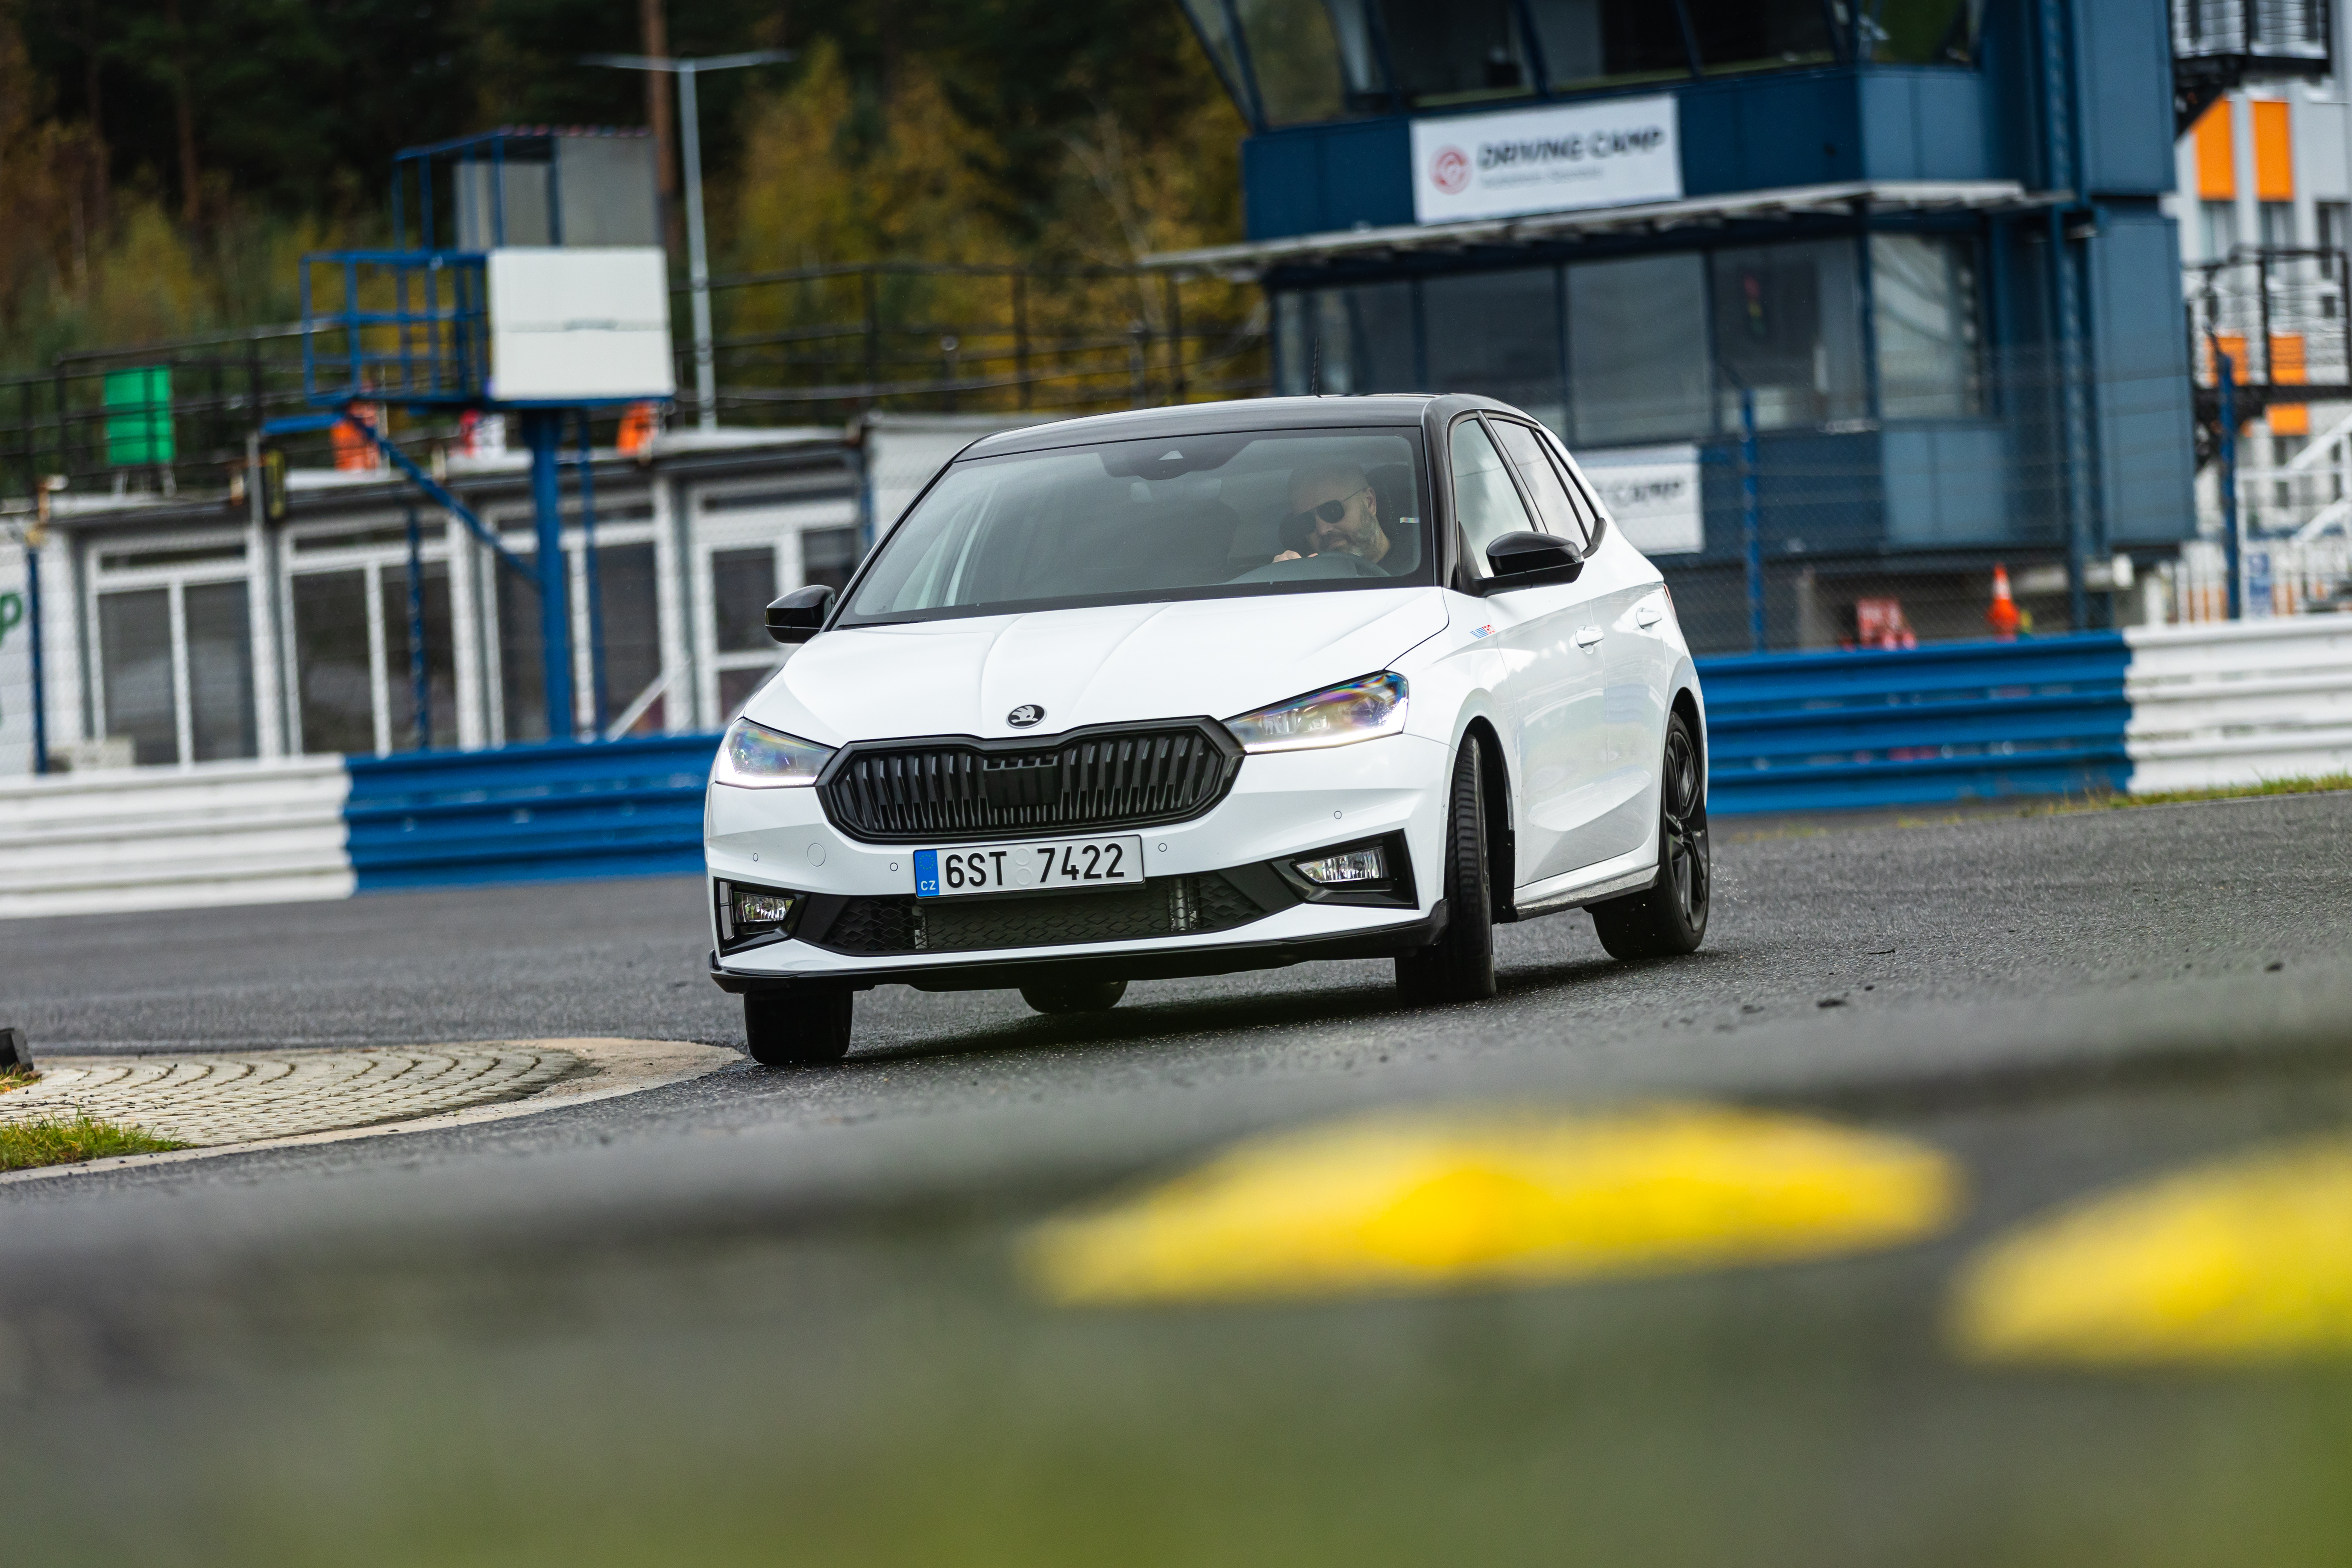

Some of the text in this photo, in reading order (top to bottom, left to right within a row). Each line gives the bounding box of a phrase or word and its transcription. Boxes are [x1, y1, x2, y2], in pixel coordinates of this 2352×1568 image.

[1477, 127, 1664, 170] DRIVING CAMP
[921, 880, 936, 891] CZ
[946, 843, 1124, 888] 6ST 7422
